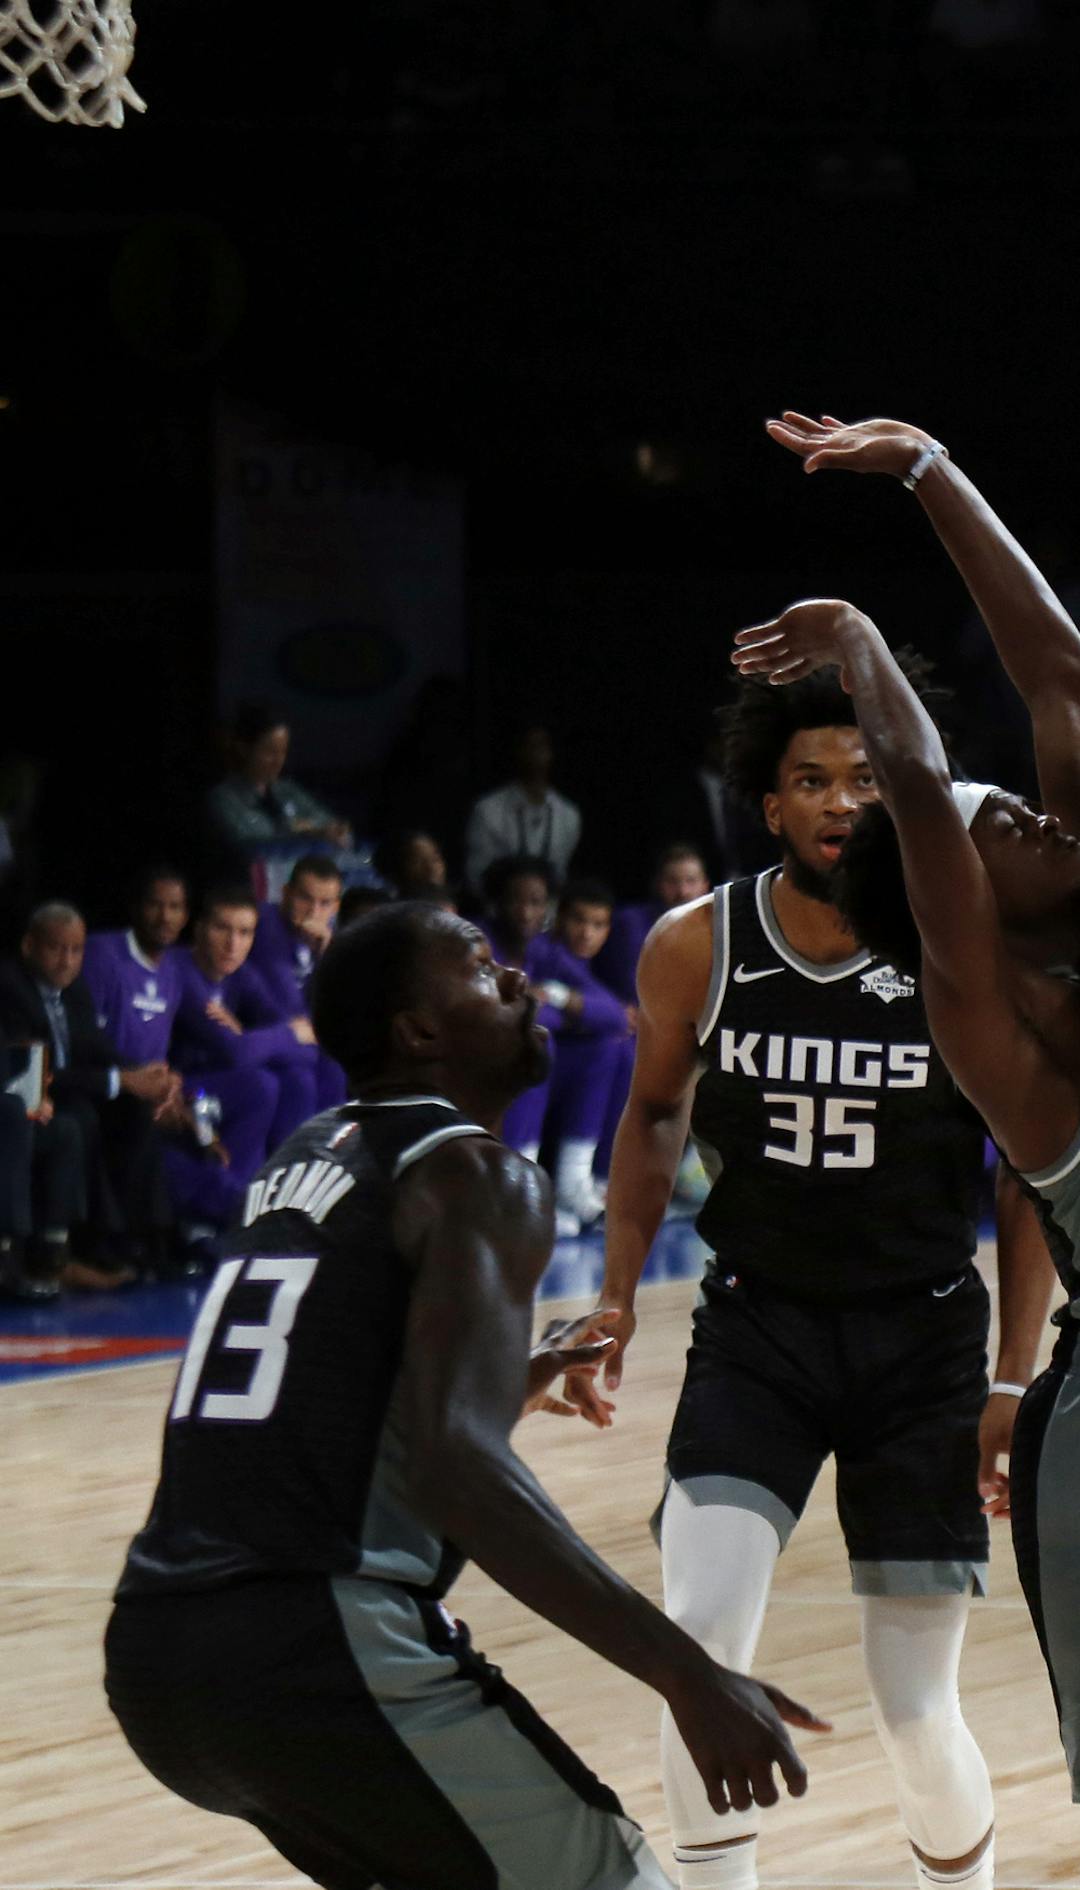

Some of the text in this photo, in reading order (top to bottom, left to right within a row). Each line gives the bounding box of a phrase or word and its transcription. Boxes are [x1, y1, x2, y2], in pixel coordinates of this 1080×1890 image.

[862, 984, 913, 996] ALMONDS
[720, 1028, 931, 1089] KINGS
[763, 1093, 877, 1169] 35
[172, 1257, 320, 1421] 13
